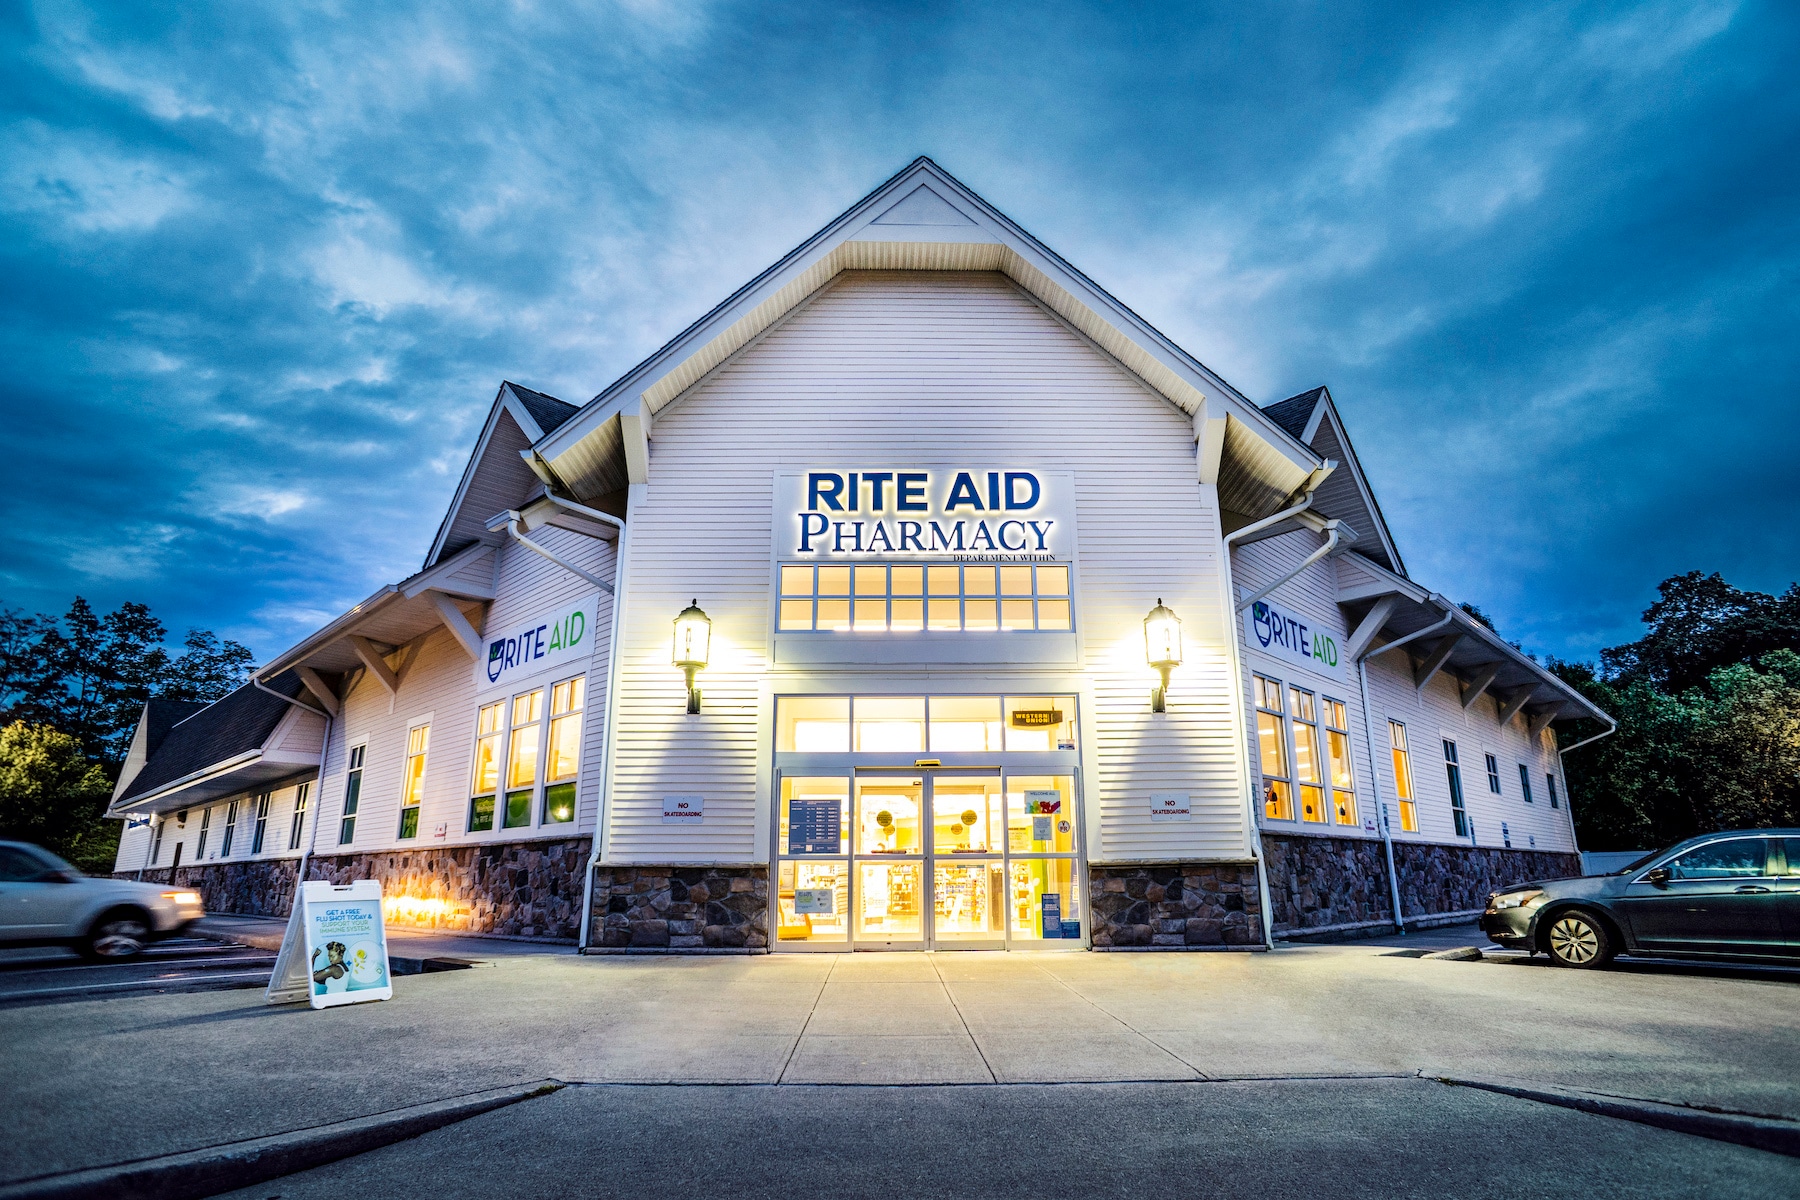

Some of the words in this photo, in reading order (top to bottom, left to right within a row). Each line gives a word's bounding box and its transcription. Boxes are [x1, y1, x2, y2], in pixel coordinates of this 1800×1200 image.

[808, 472, 928, 512] RITE
[944, 471, 1041, 512] AID
[797, 512, 1054, 553] PHARMACY
[504, 624, 547, 670] RITE
[547, 611, 585, 655] AID
[1270, 610, 1311, 657] RITE
[1313, 631, 1338, 667] AID
